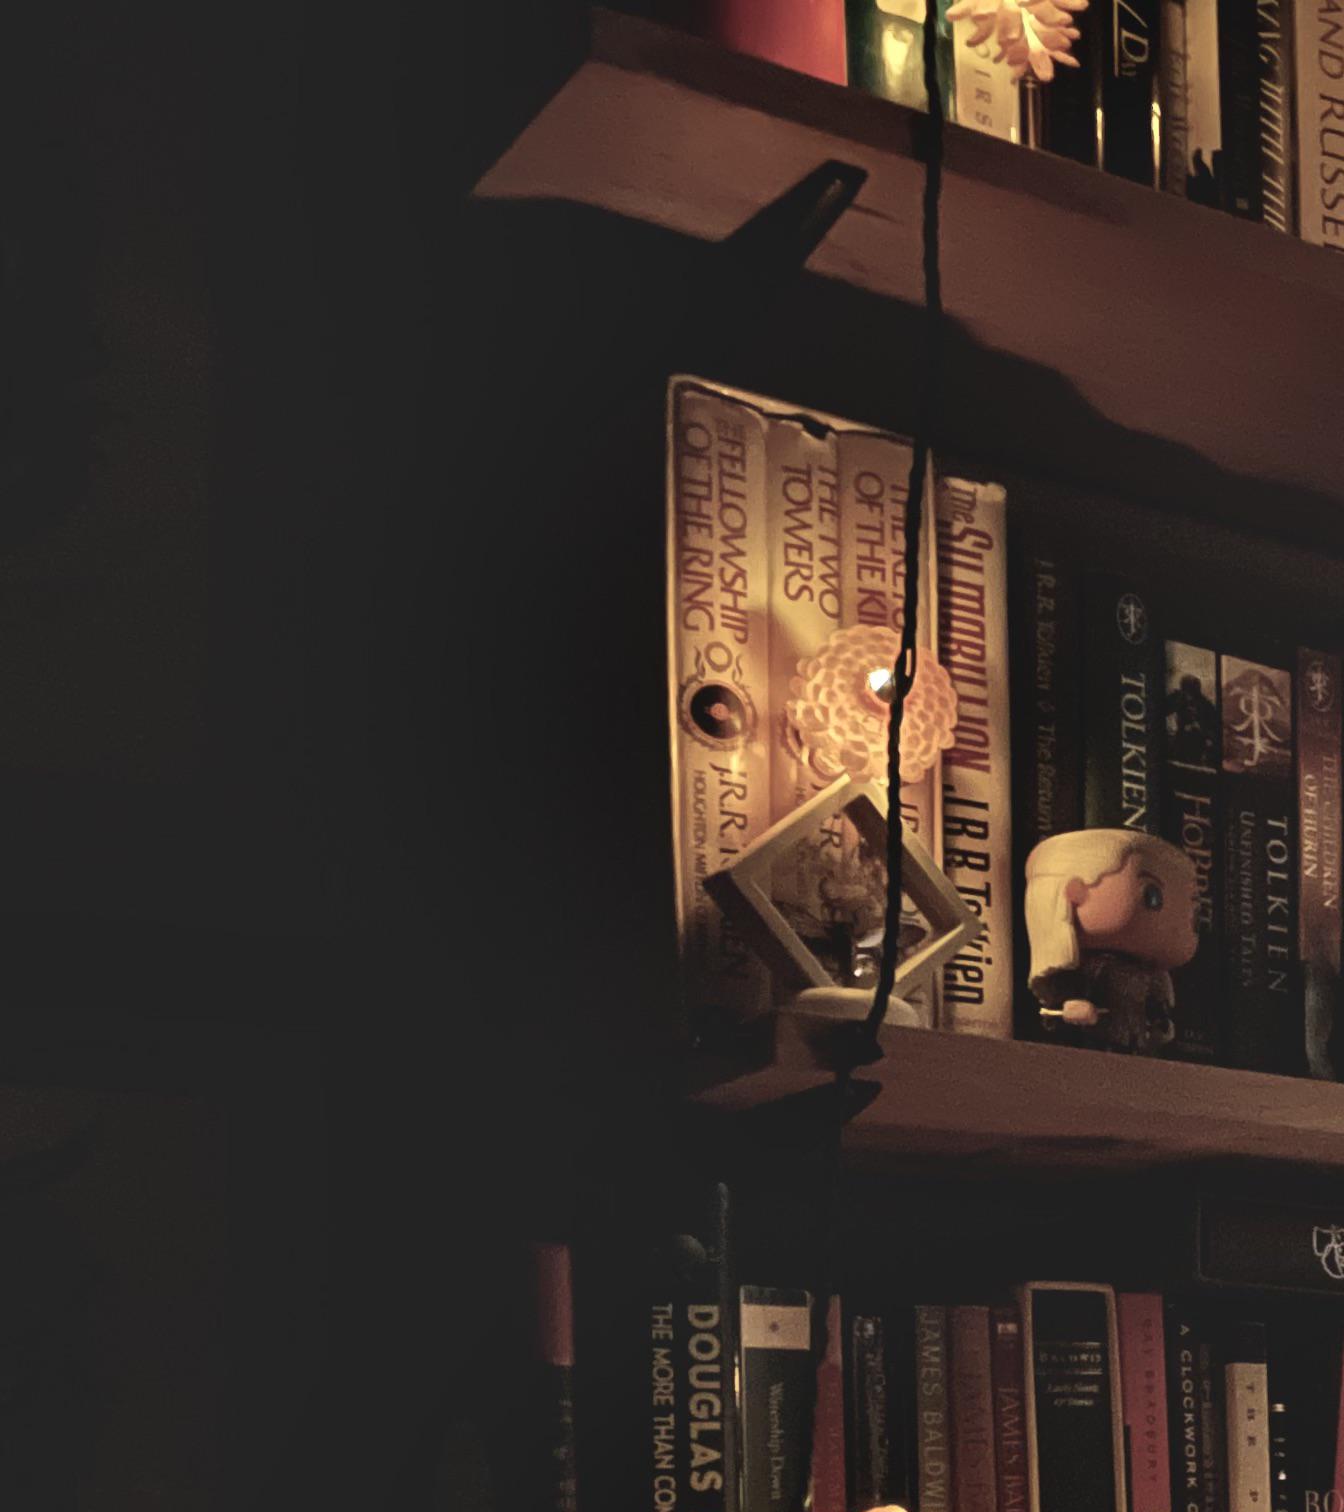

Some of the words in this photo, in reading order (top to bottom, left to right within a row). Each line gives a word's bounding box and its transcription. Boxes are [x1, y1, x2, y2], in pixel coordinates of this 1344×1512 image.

[682, 424, 715, 454] OF
[682, 457, 715, 540] THE
[782, 463, 814, 602] TOWERS
[818, 464, 841, 532] THE
[855, 470, 886, 514] OF
[719, 438, 749, 646] FELLOWSHIP
[818, 533, 841, 621] TWO
[855, 517, 886, 583] THE
[681, 548, 715, 631] RING
[1120, 672, 1148, 833] TOLKIEN
[1238, 810, 1257, 925] UNFINISHED
[1265, 815, 1290, 994] TOLKIEN
[651, 1302, 675, 1341] THE
[919, 1312, 944, 1398] JAMES
[1180, 1323, 1192, 1337] A
[651, 1347, 675, 1406] MORE
[687, 1303, 724, 1493] DOUGLAS
[1245, 1382, 1258, 1447] THE
[652, 1413, 677, 1470] THAN
[997, 1385, 1022, 1466] JAMES
[1180, 1349, 1199, 1489] CLOCKWORK
